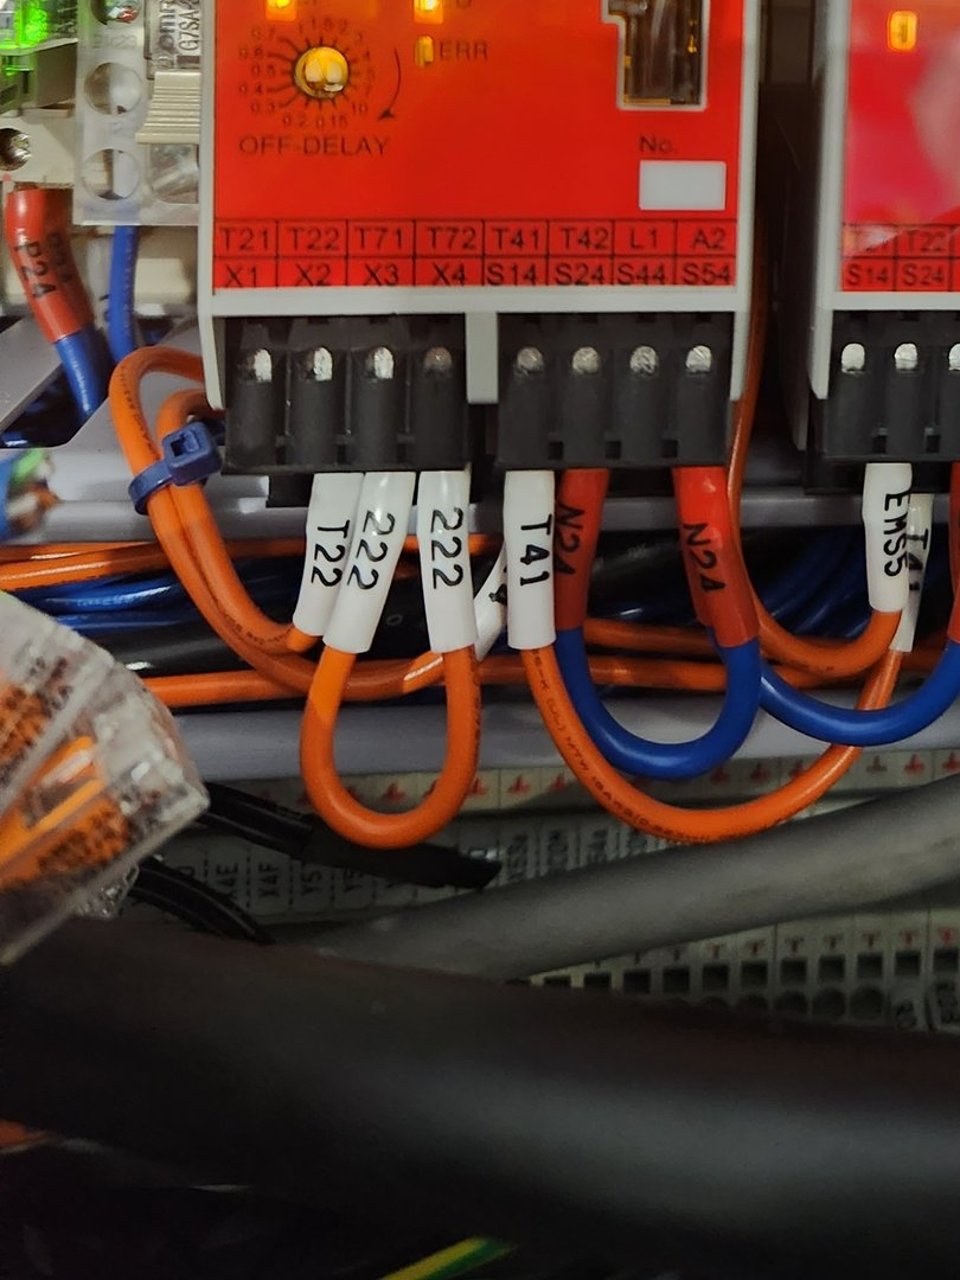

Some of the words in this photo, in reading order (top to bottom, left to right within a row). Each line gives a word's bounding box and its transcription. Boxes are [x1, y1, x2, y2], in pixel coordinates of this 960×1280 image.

[438, 40, 489, 61] ERR
[219, 228, 270, 251] T21
[289, 228, 341, 251] T22
[354, 228, 403, 251] T71
[428, 228, 478, 251] T72
[492, 228, 541, 251] T41
[559, 228, 611, 251] T42
[627, 229, 661, 251] L1
[690, 229, 727, 251] A2
[225, 263, 258, 287] X1
[296, 263, 332, 287] X2
[363, 263, 401, 286] X3
[430, 262, 467, 286] X4
[486, 261, 538, 286] S14
[553, 261, 605, 286] S24
[616, 261, 668, 286] S44
[681, 261, 732, 285] S54
[846, 262, 889, 286] S14
[902, 262, 946, 287] S24
[310, 519, 351, 587] T22
[346, 509, 395, 591] 222
[431, 507, 464, 591] 222
[519, 513, 554, 587] T41
[683, 523, 726, 594] N24
[883, 490, 910, 578] EMS5
